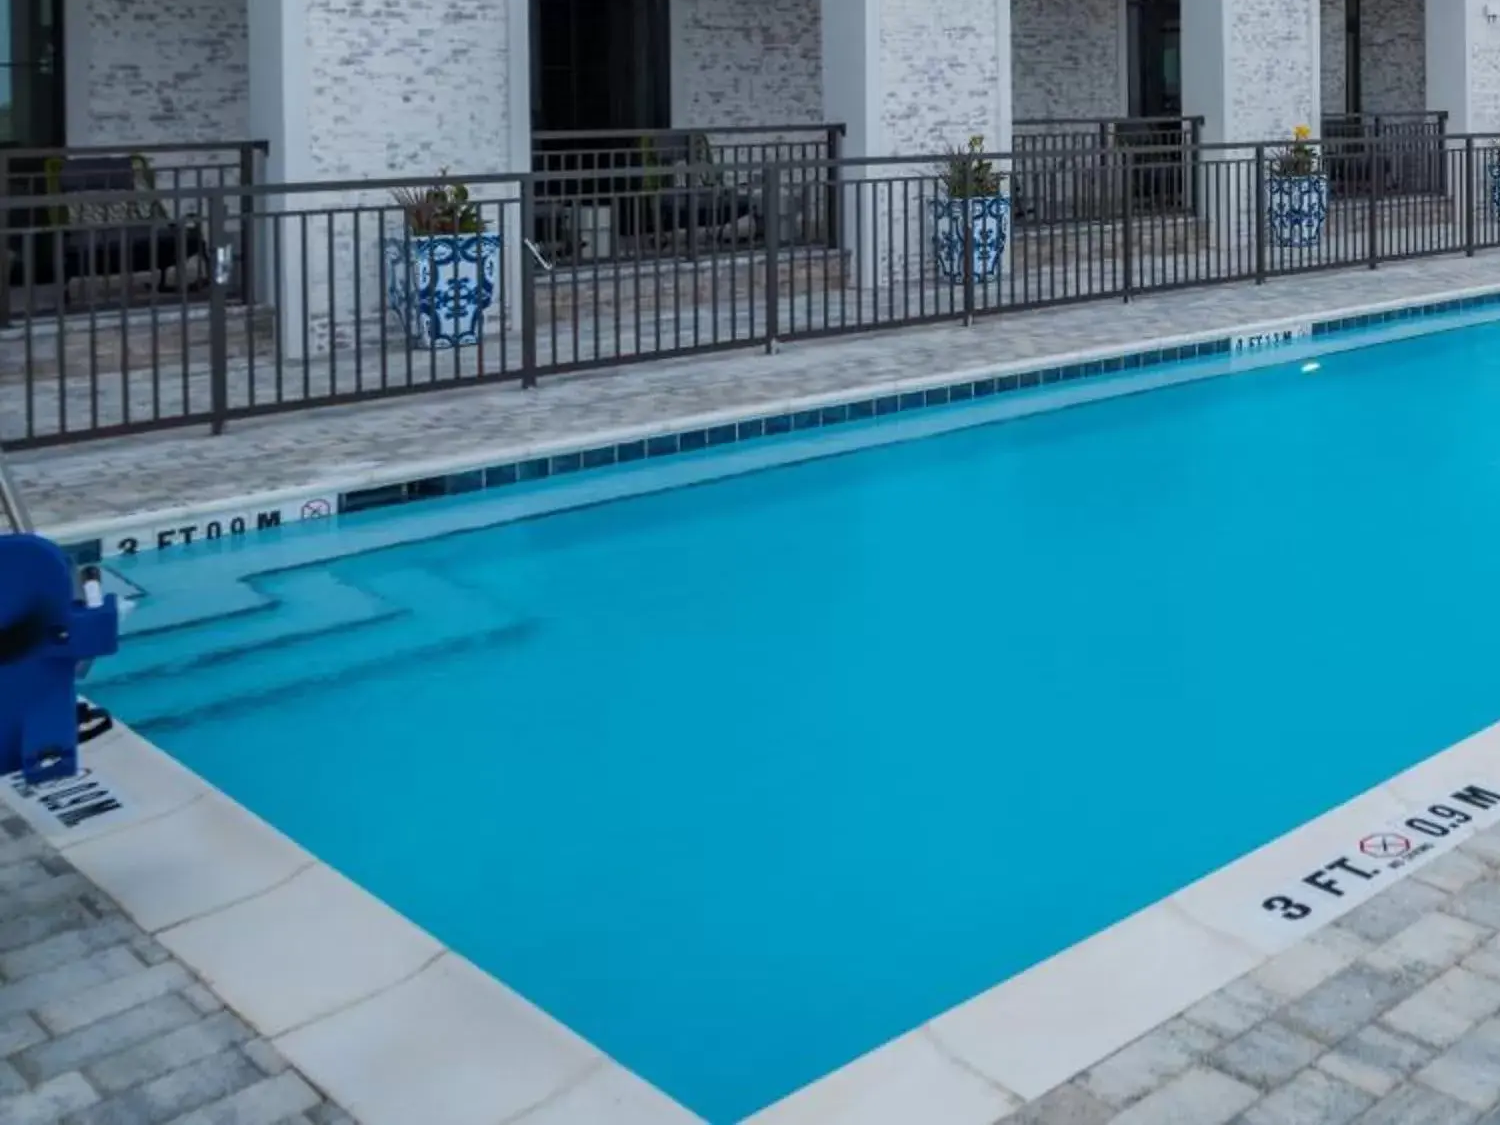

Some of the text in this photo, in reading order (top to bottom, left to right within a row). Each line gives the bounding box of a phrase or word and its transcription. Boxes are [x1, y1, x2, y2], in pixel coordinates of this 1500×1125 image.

[156, 526, 198, 551] FT
[257, 510, 282, 530] M
[1262, 895, 1312, 921] 3
[1302, 856, 1382, 898] FT.
[1405, 804, 1473, 838] 0.9
